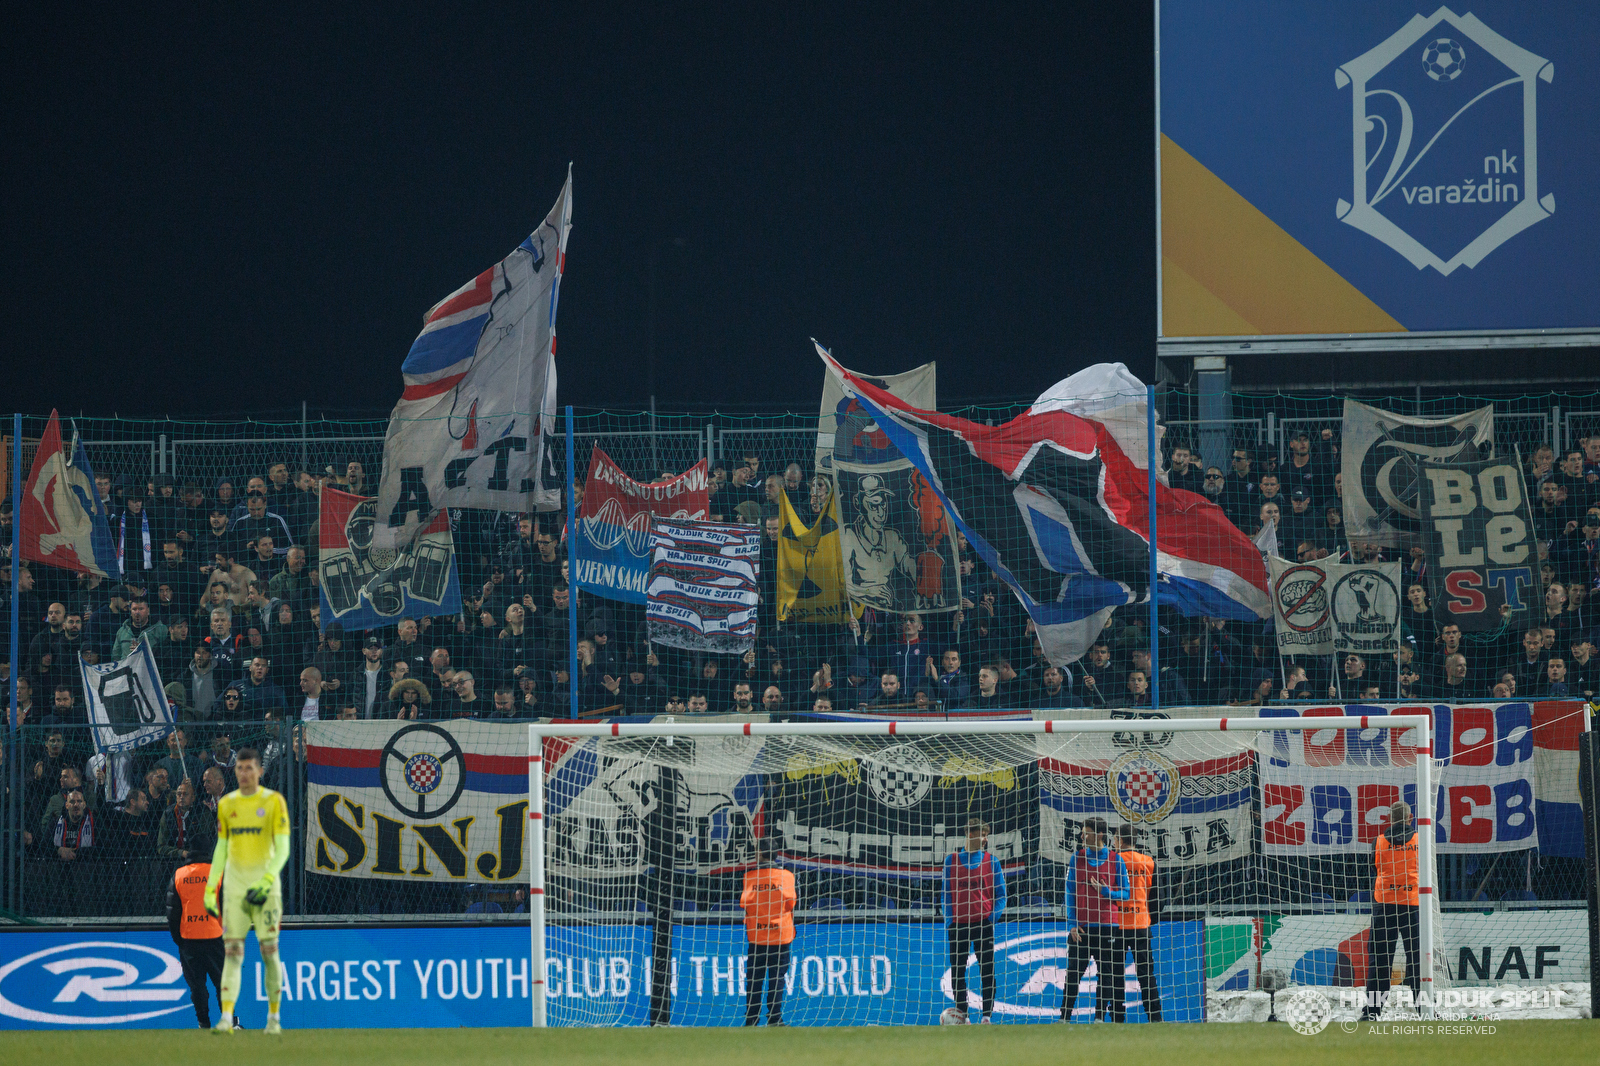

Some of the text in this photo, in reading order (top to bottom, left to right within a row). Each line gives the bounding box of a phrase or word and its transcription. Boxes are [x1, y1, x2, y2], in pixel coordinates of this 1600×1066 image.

[1484, 149, 1518, 174] nk
[1402, 178, 1519, 205] varaždin
[1424, 464, 1522, 516] BO
[668, 528, 704, 538] HAJDUK
[706, 532, 730, 543] SPLIT
[667, 551, 732, 568] HAJDUK SPLIT
[576, 559, 617, 588] VJERNI
[675, 581, 744, 600] HAJDUK SPLIT
[1444, 566, 1532, 614] ST
[665, 605, 694, 619] SPLIT
[107, 729, 166, 754] SHOP
[1258, 702, 1534, 768] TORCIDA
[407, 754, 440, 767] HAJDUK
[409, 782, 434, 793] SPLIT
[878, 791, 918, 807] SPLIT
[1124, 798, 1160, 814] SPLIT
[314, 792, 530, 881] SINJ
[182, 876, 214, 884] REDA
[187, 915, 209, 923] R741
[255, 959, 401, 1001] LARGEST
[413, 958, 529, 1000] YOUTH
[544, 957, 632, 999] CLUB
[689, 956, 747, 997] THE
